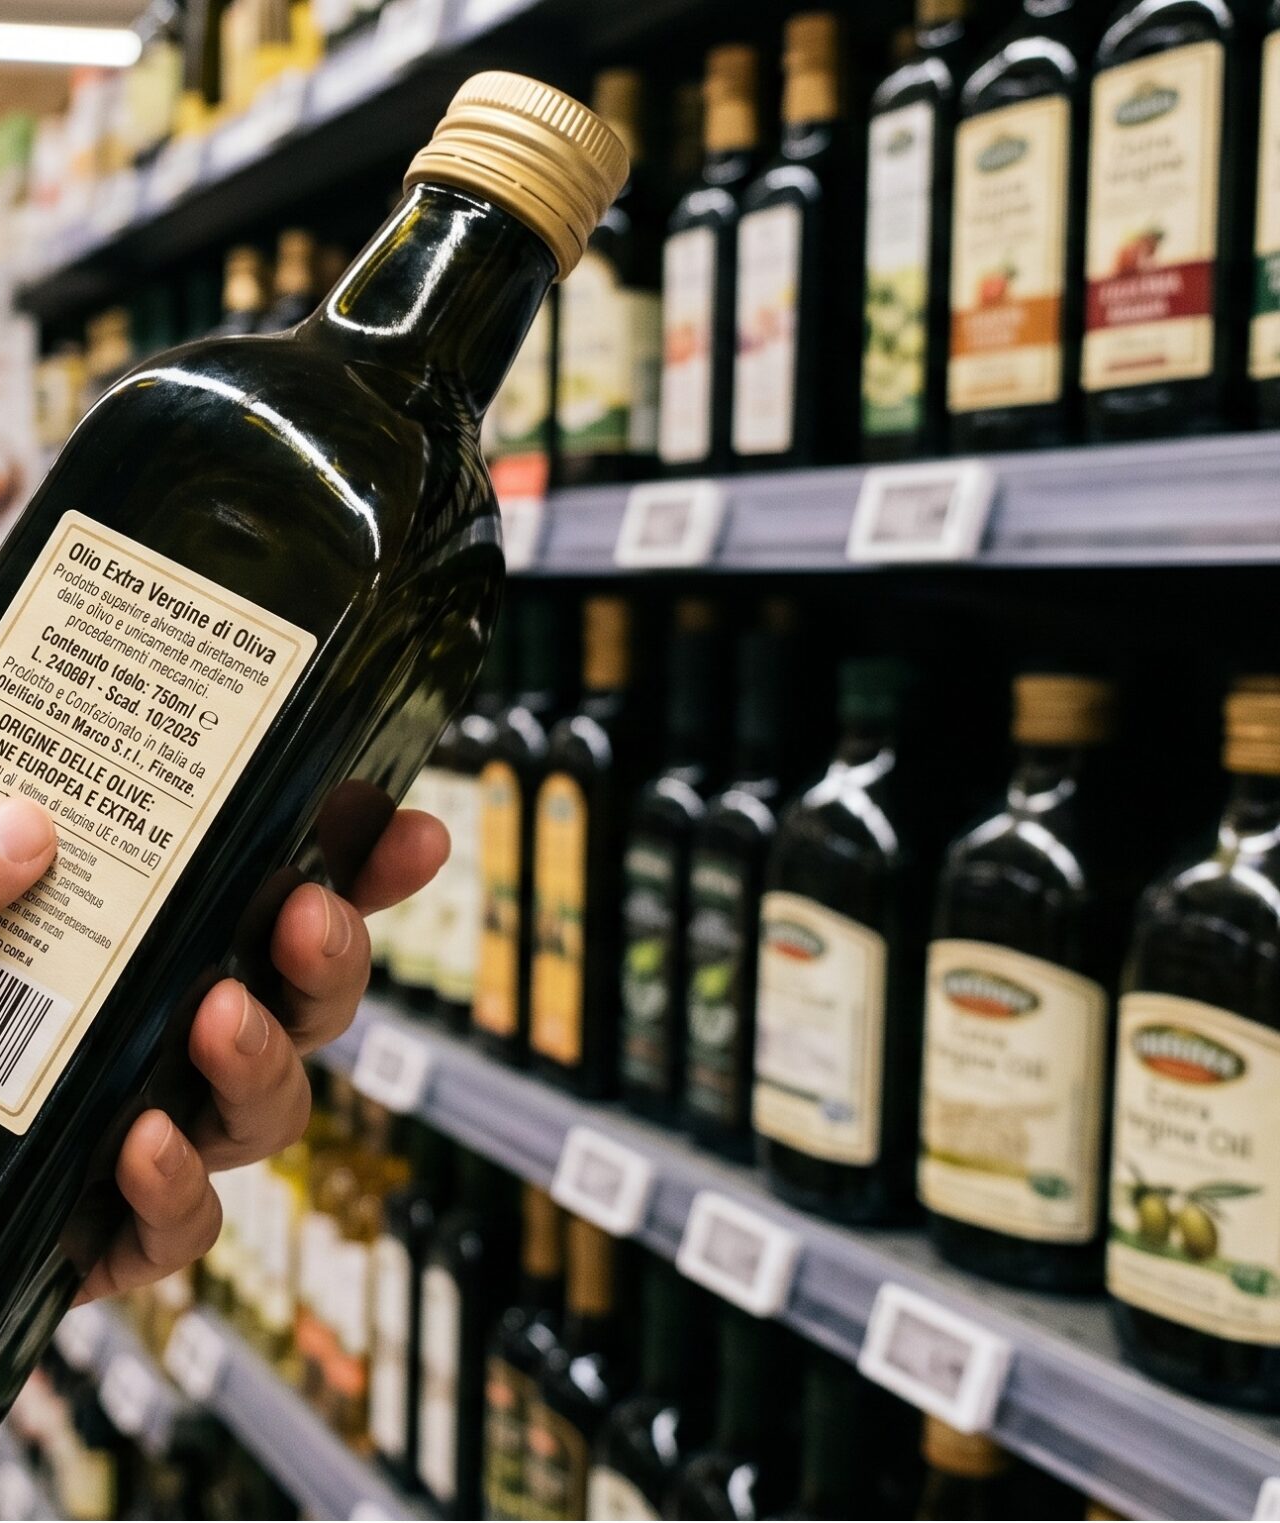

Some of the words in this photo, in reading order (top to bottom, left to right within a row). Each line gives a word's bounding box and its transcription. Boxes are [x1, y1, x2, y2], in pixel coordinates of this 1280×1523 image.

[52, 562, 99, 596] Prodotto
[68, 542, 101, 571] Olio
[101, 559, 144, 594] Extra
[147, 581, 210, 628] Vergine
[211, 619, 233, 639] di
[232, 628, 276, 664] Oliva
[41, 625, 109, 672] Contenuto
[151, 684, 197, 718] 750ml
[114, 619, 123, 630] e
[124, 624, 189, 665] unicamente
[148, 658, 209, 698] meccanici.
[29, 644, 44, 667] L.
[104, 685, 141, 716] Scad.
[145, 707, 200, 747] 10/2025
[55, 688, 64, 699] e
[142, 733, 156, 751] in
[156, 741, 188, 768] Italia
[188, 761, 205, 779] da
[45, 701, 70, 725] San
[70, 715, 110, 747] Marco
[147, 758, 194, 797] Firenze.
[57, 746, 107, 784] DELLE
[105, 774, 155, 811] OLIVE:
[15, 750, 84, 800] EUROPEA
[83, 789, 99, 807] E
[96, 796, 146, 835] EXTRA
[148, 825, 173, 849] UE
[48, 798, 62, 812] di
[95, 822, 113, 841] UE
[110, 834, 119, 845] e
[118, 839, 140, 857] non
[140, 848, 161, 870] UE)
